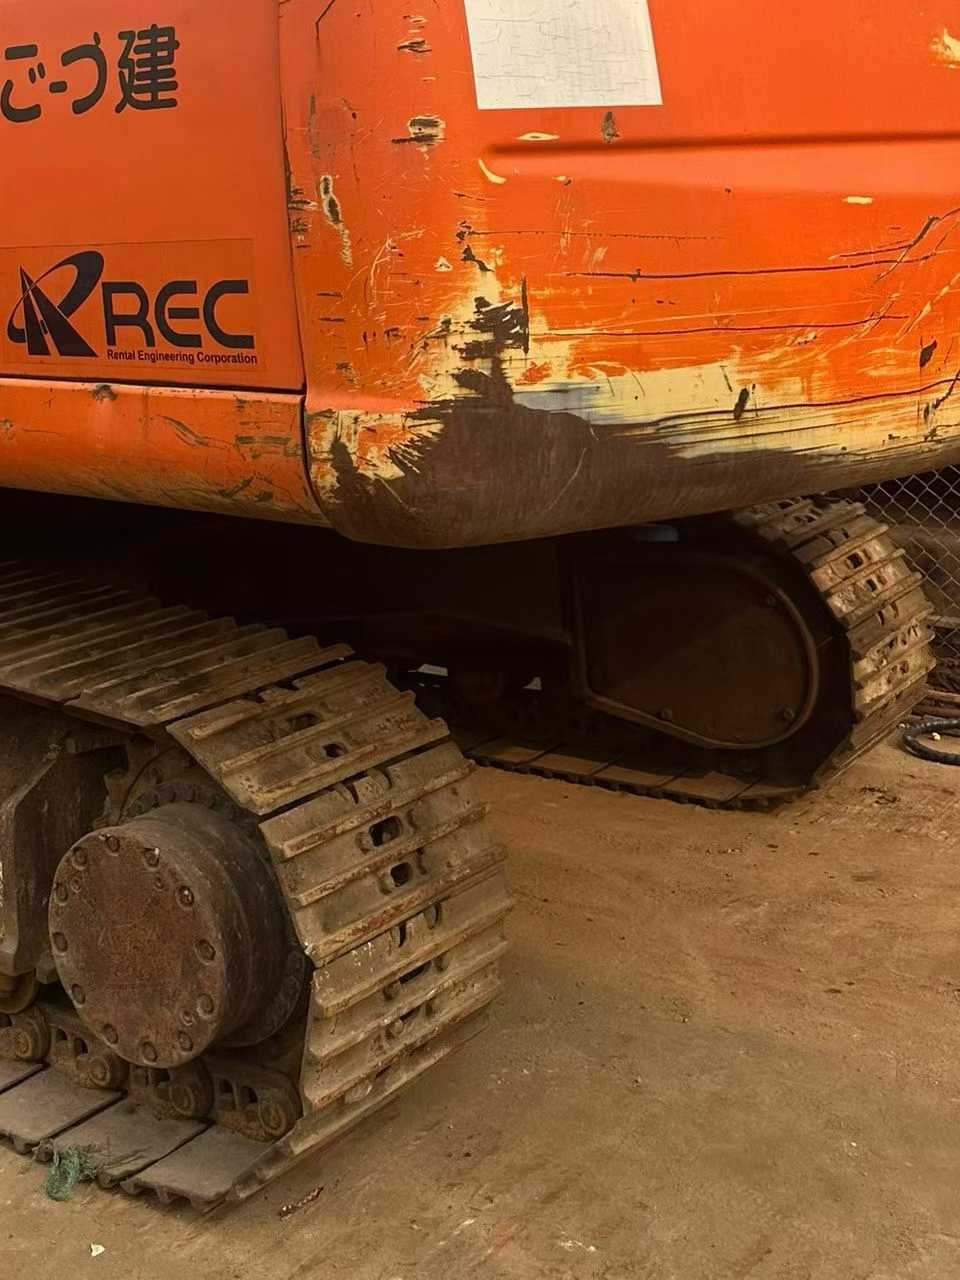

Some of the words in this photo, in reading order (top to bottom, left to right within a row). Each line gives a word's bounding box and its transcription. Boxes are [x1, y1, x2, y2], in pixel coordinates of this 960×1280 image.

[102, 280, 255, 349] REC
[106, 349, 136, 361] Rental
[138, 350, 194, 365] Engineering
[196, 351, 258, 365] Corporation
